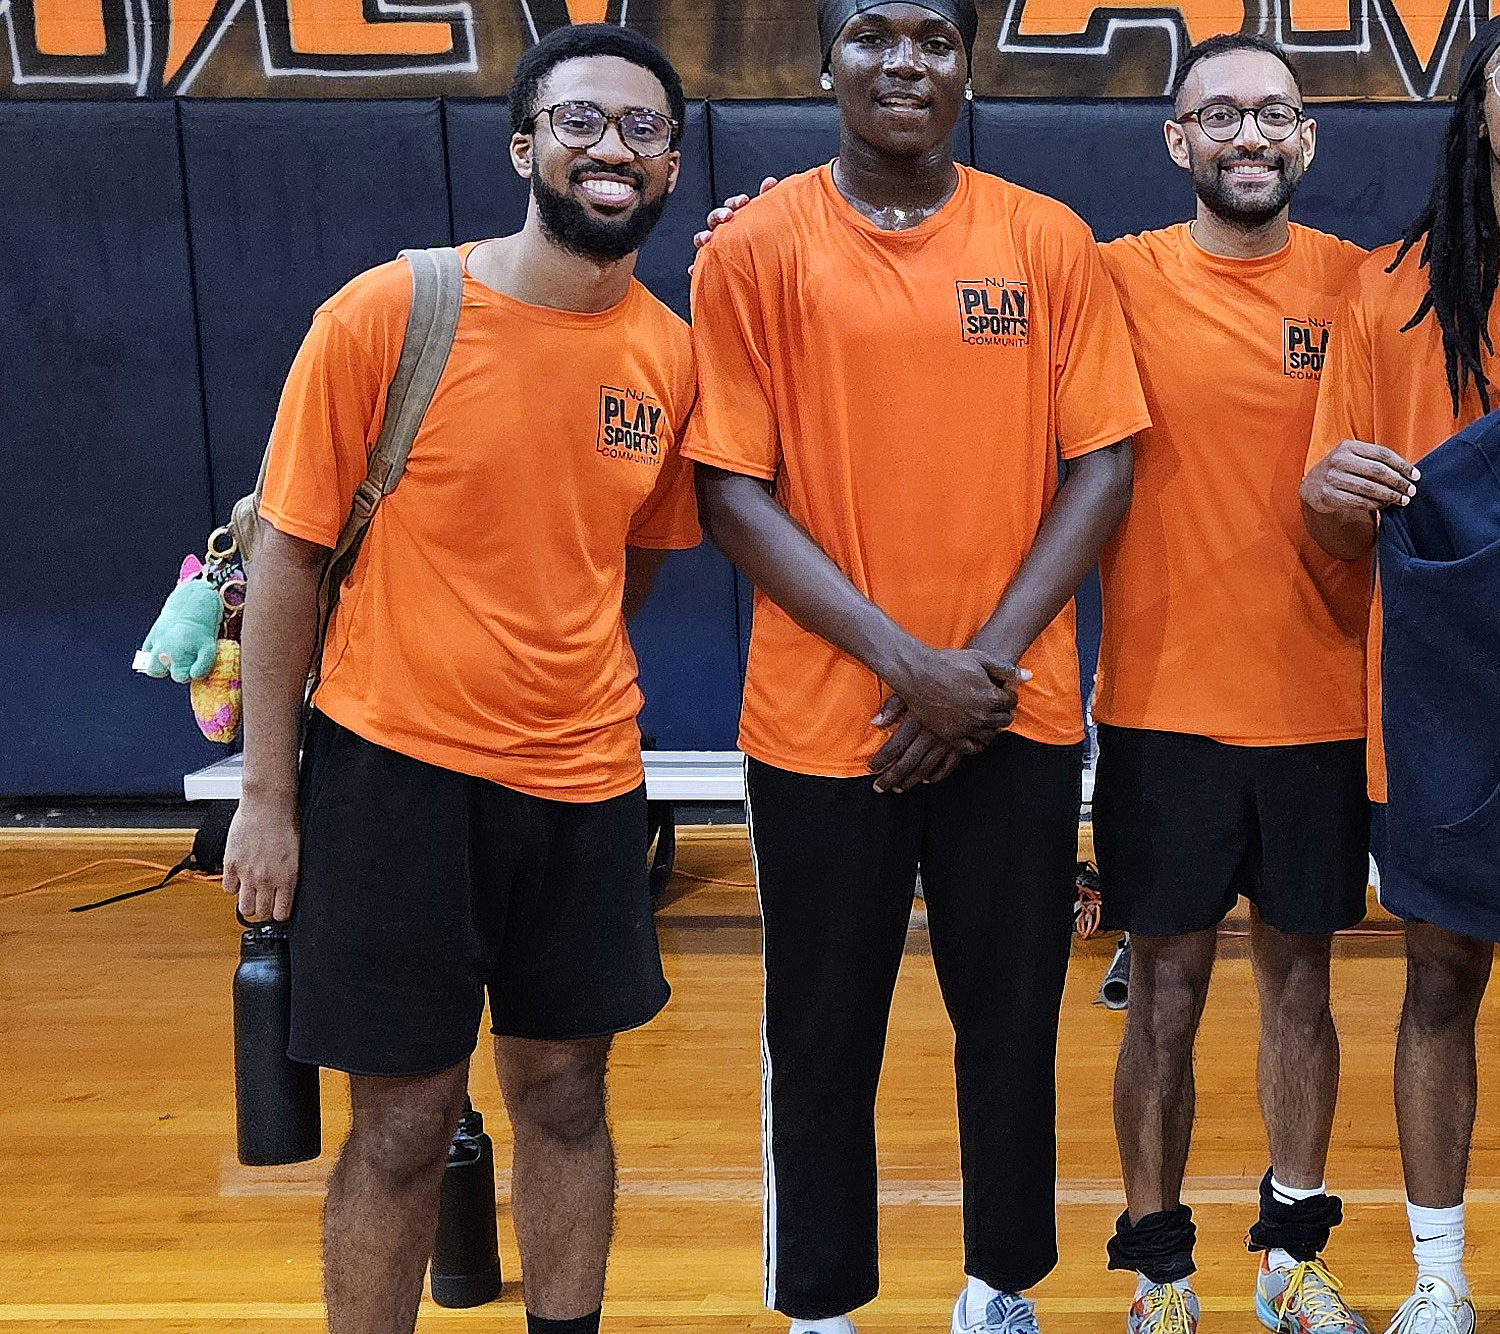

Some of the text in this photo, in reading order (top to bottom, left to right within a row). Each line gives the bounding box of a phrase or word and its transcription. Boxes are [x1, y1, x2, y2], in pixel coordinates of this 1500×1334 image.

[985, 277, 1005, 287] NJ
[962, 289, 1026, 317] PLAY
[967, 316, 1028, 336] SPORTS
[1308, 317, 1326, 327] NJ
[968, 337, 1024, 347] COMMUNIT
[626, 387, 645, 401] NJ
[604, 395, 662, 435] PLAY
[603, 425, 658, 455] SPORTS
[602, 447, 657, 465] COMMUNITY
